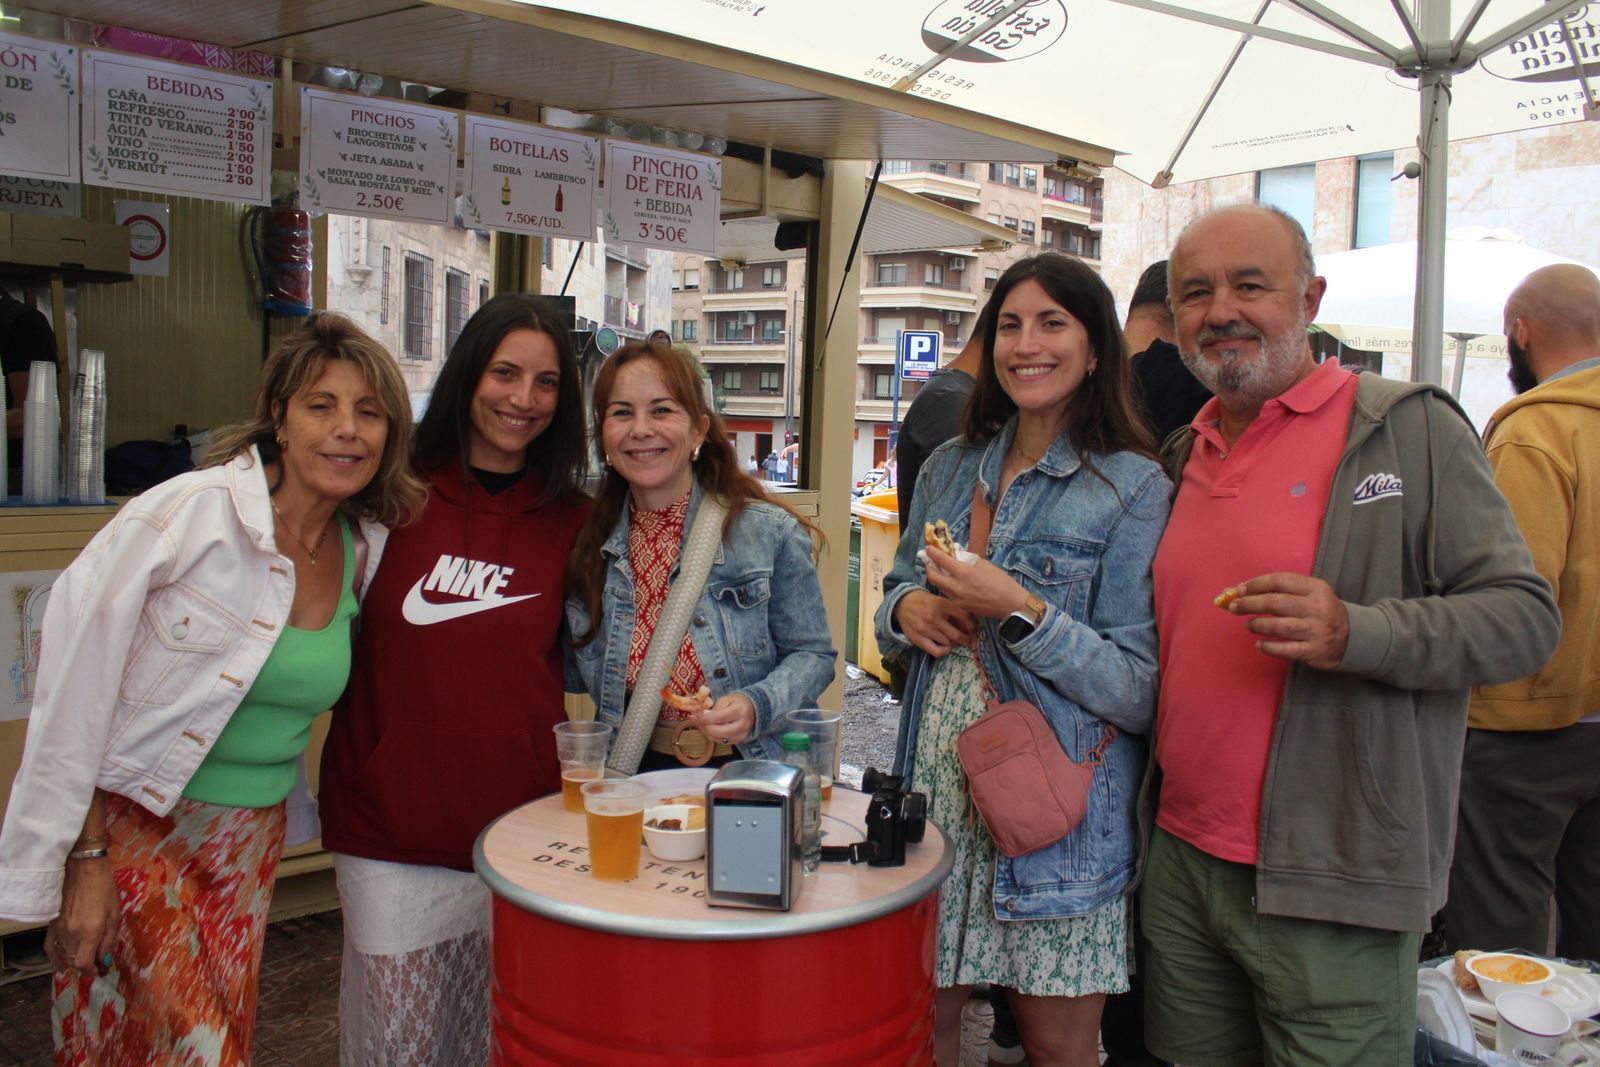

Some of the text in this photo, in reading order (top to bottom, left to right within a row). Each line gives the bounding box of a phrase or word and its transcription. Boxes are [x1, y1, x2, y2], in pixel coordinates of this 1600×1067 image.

[108, 88, 148, 103] CAÑA
[147, 76, 225, 101] BEBIDAS
[107, 100, 186, 121] REFRESCO
[351, 109, 416, 130] PINCHOS
[107, 123, 148, 138] AGUA
[108, 112, 152, 127] TINTO
[157, 118, 214, 136] VERANO
[107, 135, 143, 149] VINO
[346, 136, 415, 152] LANGOSTINOS
[347, 127, 416, 144] BROCHETA DE
[107, 147, 159, 164] MOSTO
[490, 137, 569, 163] BOTELLAS
[350, 154, 414, 170] JETA ASADA
[633, 155, 698, 181] PINCHO
[327, 168, 436, 188] MONTADO DE LOMO CON
[492, 163, 586, 185] SIDRA LAMBRUSCO
[327, 176, 432, 196] SALSA MOSTAZA Y MIEL
[626, 174, 703, 201] DE FERIA
[356, 192, 405, 210] 2,50€
[634, 198, 693, 217] + BEBIDA
[638, 222, 688, 244] 3'50€
[910, 336, 931, 360] P
[423, 554, 515, 600] NIKE
